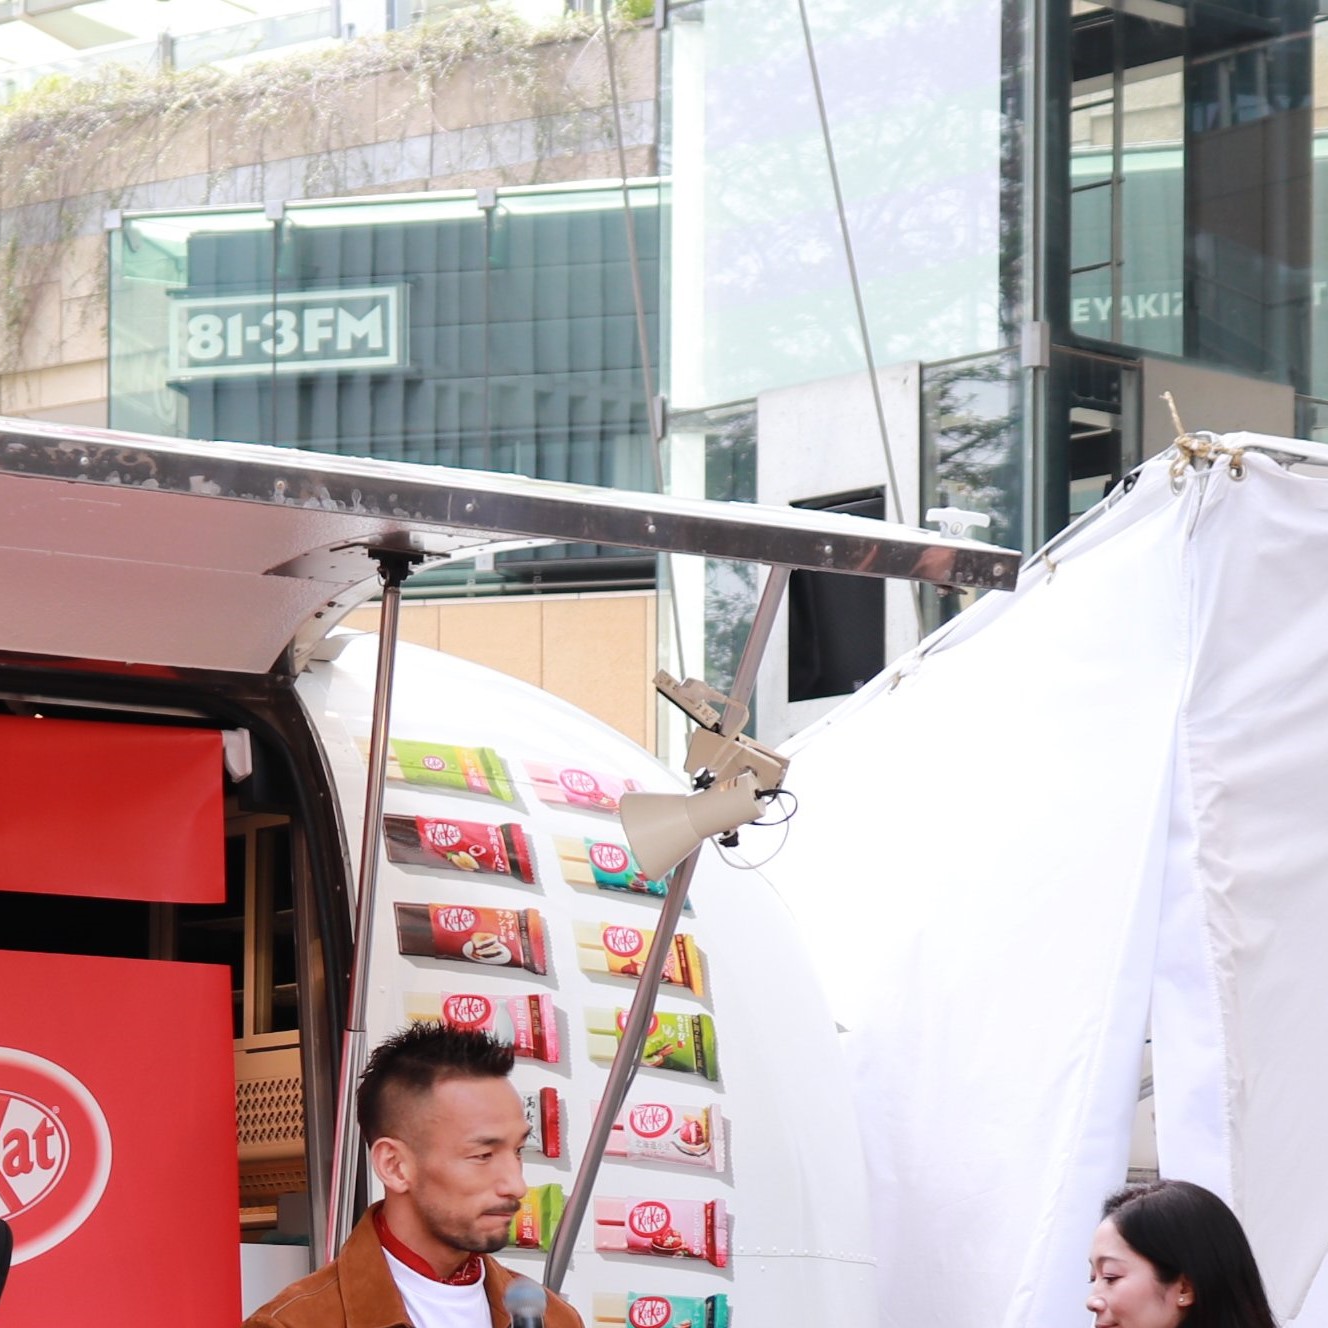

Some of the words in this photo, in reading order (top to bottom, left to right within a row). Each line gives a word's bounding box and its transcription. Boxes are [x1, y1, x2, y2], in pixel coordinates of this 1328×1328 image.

[429, 823, 460, 846] KitKat
[596, 844, 628, 869] KitKat
[440, 907, 476, 932] KitKat
[608, 927, 640, 953] KitKat
[451, 998, 484, 1024] KitKat
[638, 1106, 666, 1130] KitKat
[636, 1206, 665, 1233] KitKat
[637, 1301, 665, 1326] KitKat
